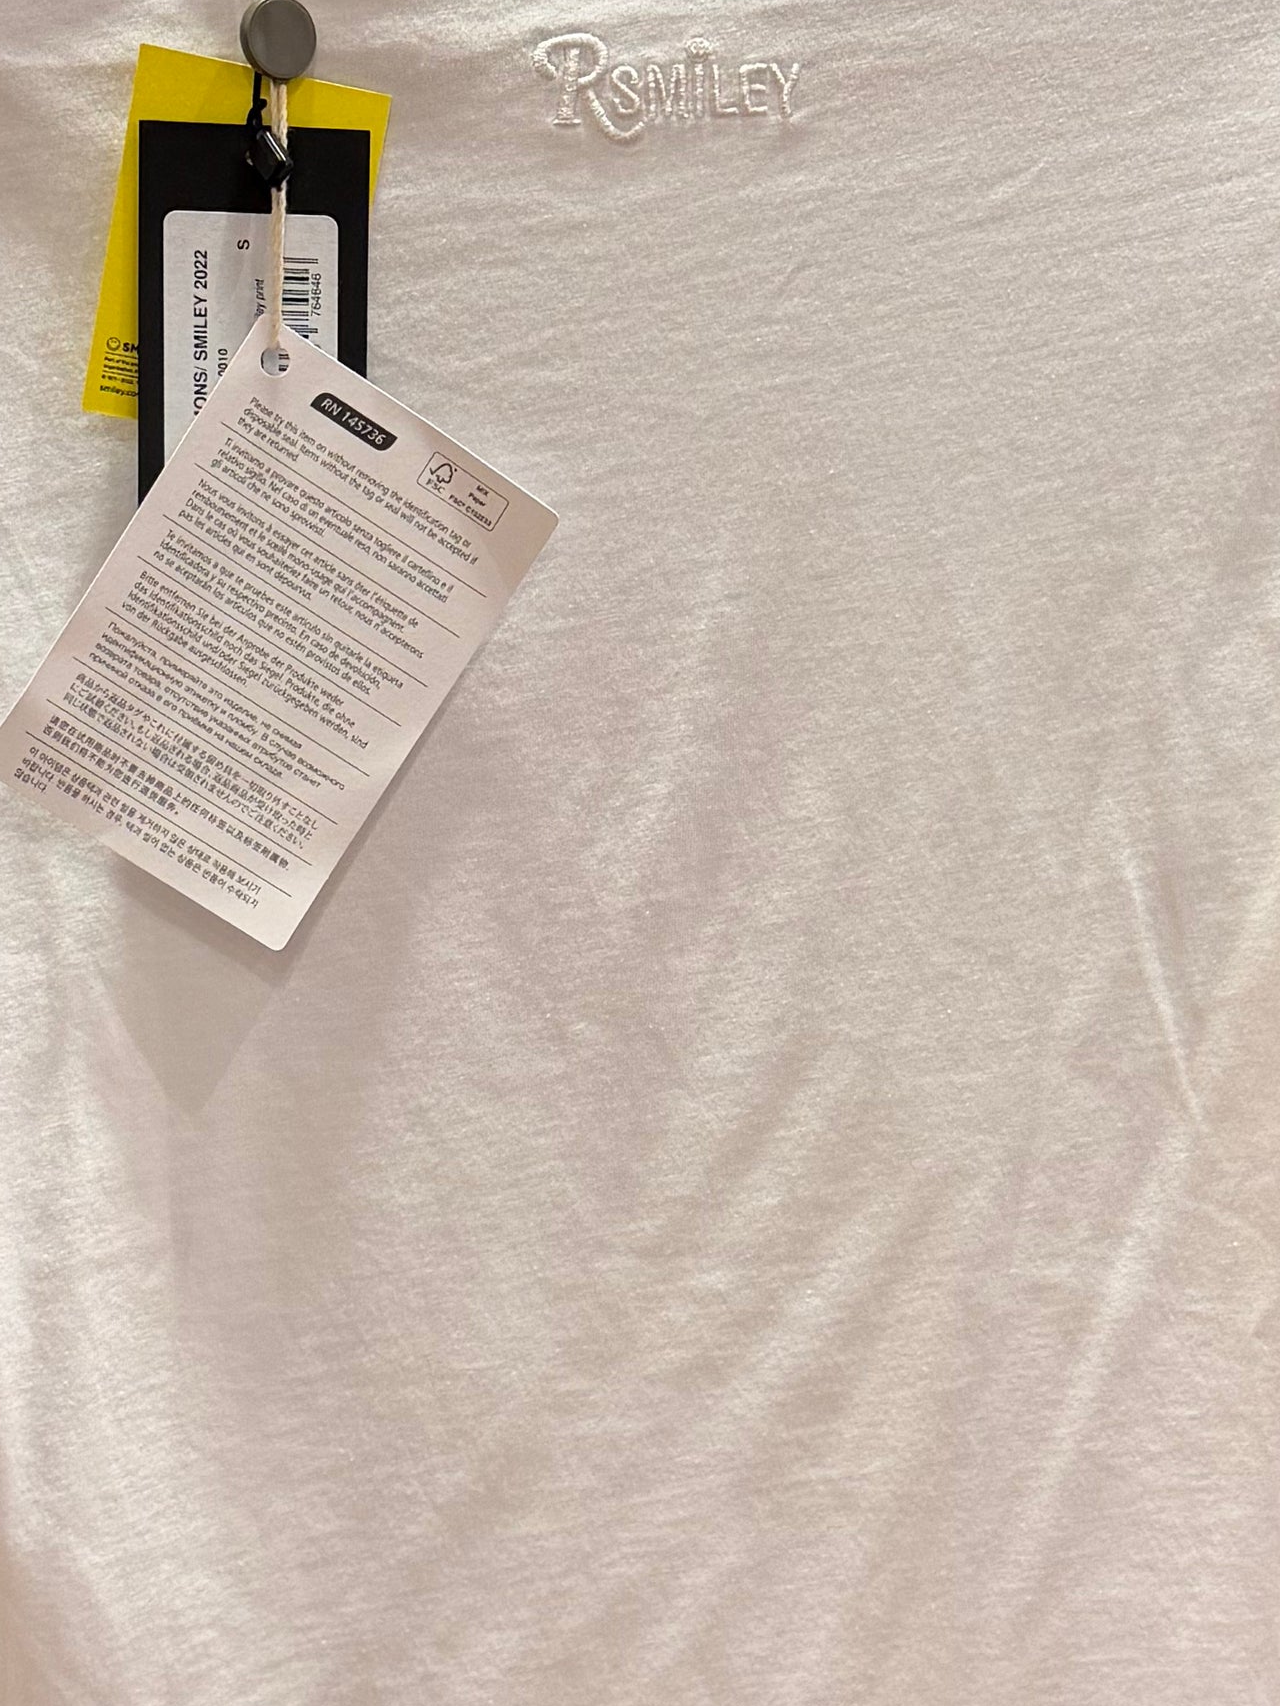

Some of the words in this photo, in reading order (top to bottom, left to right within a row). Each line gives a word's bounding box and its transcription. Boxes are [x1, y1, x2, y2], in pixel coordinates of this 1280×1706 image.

[237, 239, 250, 250] S
[193, 250, 208, 289] 2022
[255, 279, 265, 301] print
[193, 295, 208, 361] SMILEY
[321, 397, 341, 416] RN
[341, 410, 387, 446] 145736
